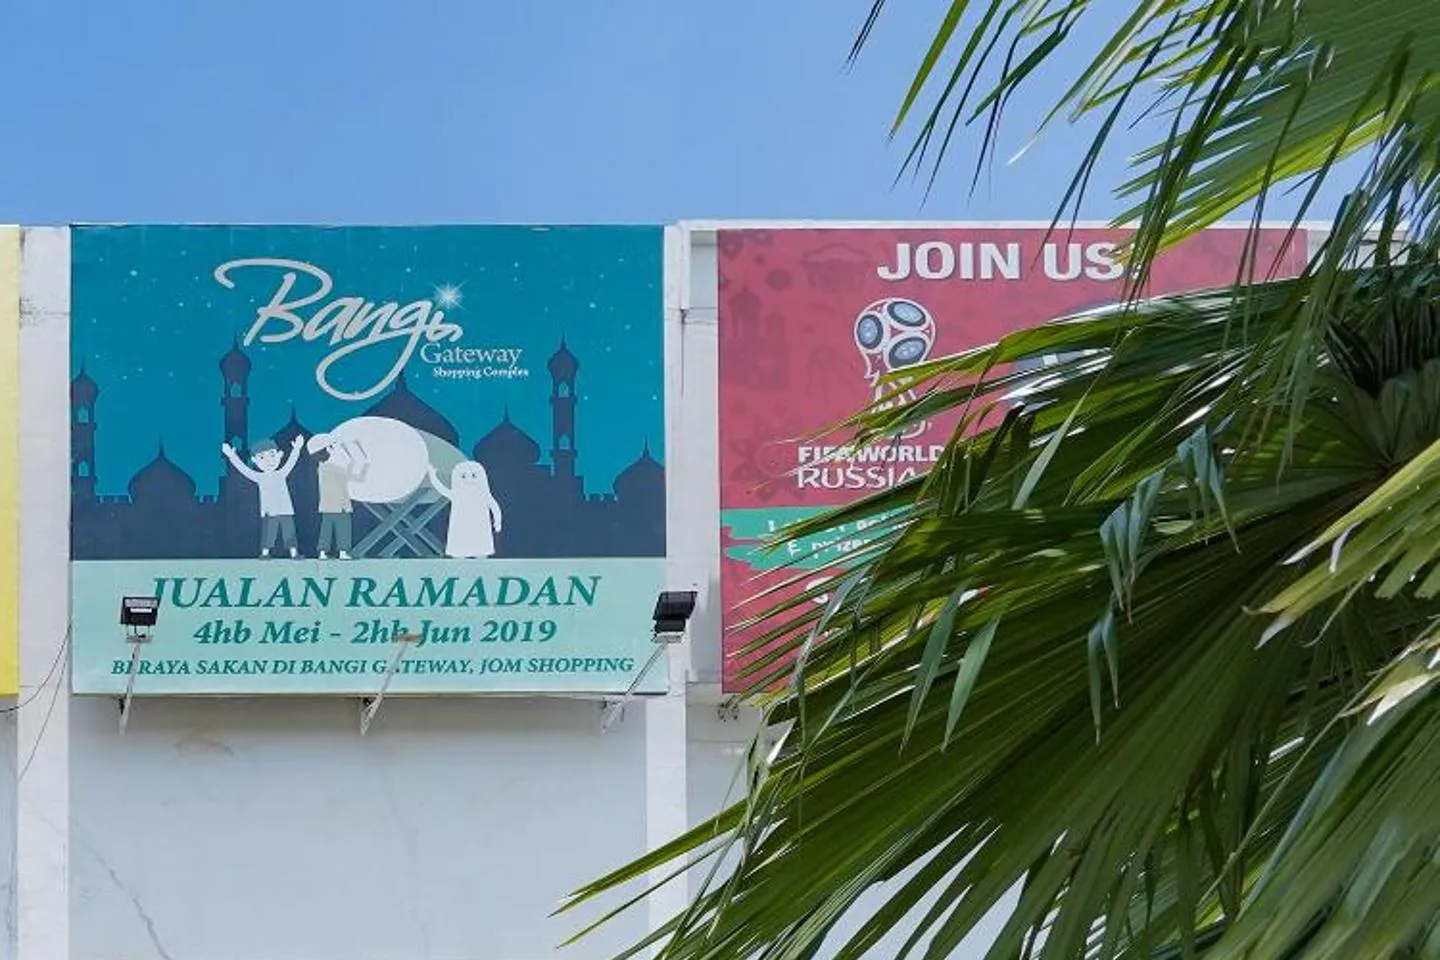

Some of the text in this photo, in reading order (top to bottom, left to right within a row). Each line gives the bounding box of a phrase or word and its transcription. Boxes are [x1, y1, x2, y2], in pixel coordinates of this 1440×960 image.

[876, 241, 1020, 280] JOIN
[213, 257, 464, 401] Bangi
[420, 342, 524, 370] Gateway
[433, 366, 530, 380] Shopping Complex
[857, 445, 946, 462] WORLD
[797, 466, 918, 489] RUSSIA
[154, 575, 602, 609] JUALAN RAMADAN
[193, 620, 252, 645] 4hb
[259, 620, 321, 645] Mei
[350, 619, 410, 645] 2hb
[415, 619, 471, 648] Jun
[480, 619, 557, 643] 2019
[196, 659, 268, 675] SAKAN
[272, 659, 296, 675] DI
[300, 659, 366, 674] BANGI
[371, 658, 474, 675] GTEWAY,
[480, 657, 522, 674] JOM
[527, 656, 635, 672] SHOPPING
